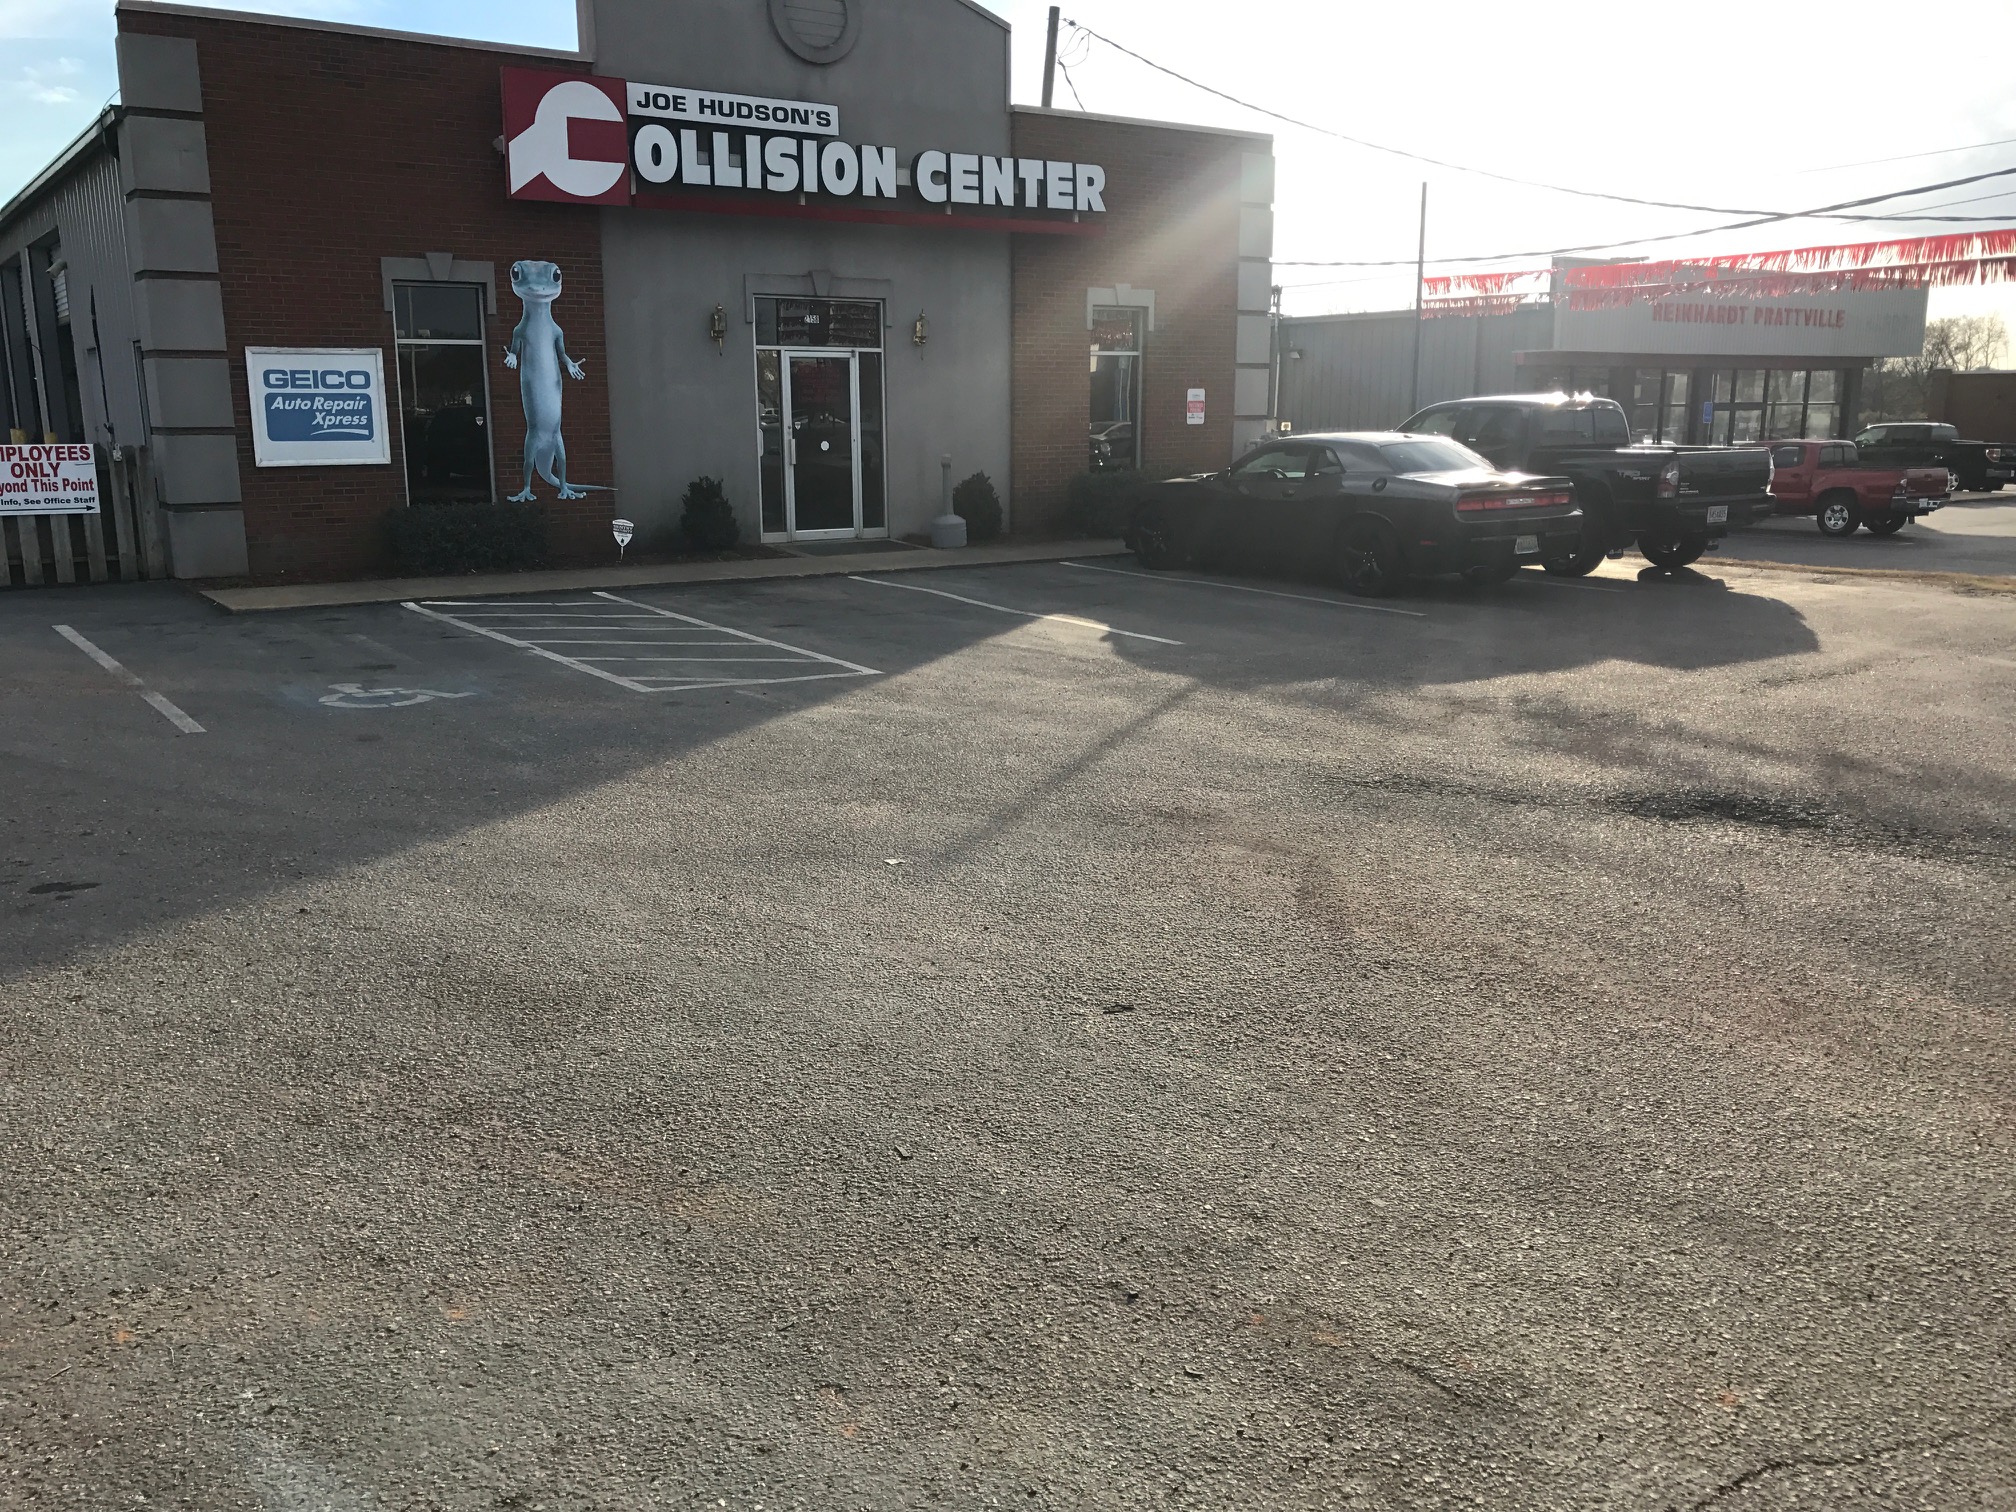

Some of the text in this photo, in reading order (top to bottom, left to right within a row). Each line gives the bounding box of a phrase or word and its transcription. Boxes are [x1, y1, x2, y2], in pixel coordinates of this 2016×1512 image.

[636, 90, 832, 128] JOE HUDSON'S
[916, 149, 1107, 212] CENTER
[1652, 302, 1846, 329] REINHARDT PRATTVILLE
[263, 369, 371, 390] GEICO
[270, 396, 367, 413] Auto Repair
[312, 412, 368, 429] Xpress
[10, 462, 61, 478] ONLY
[31, 478, 59, 492] This
[62, 478, 95, 492] Point
[1, 498, 22, 507] Info,
[44, 497, 71, 505] Office
[74, 496, 96, 504] Staff
